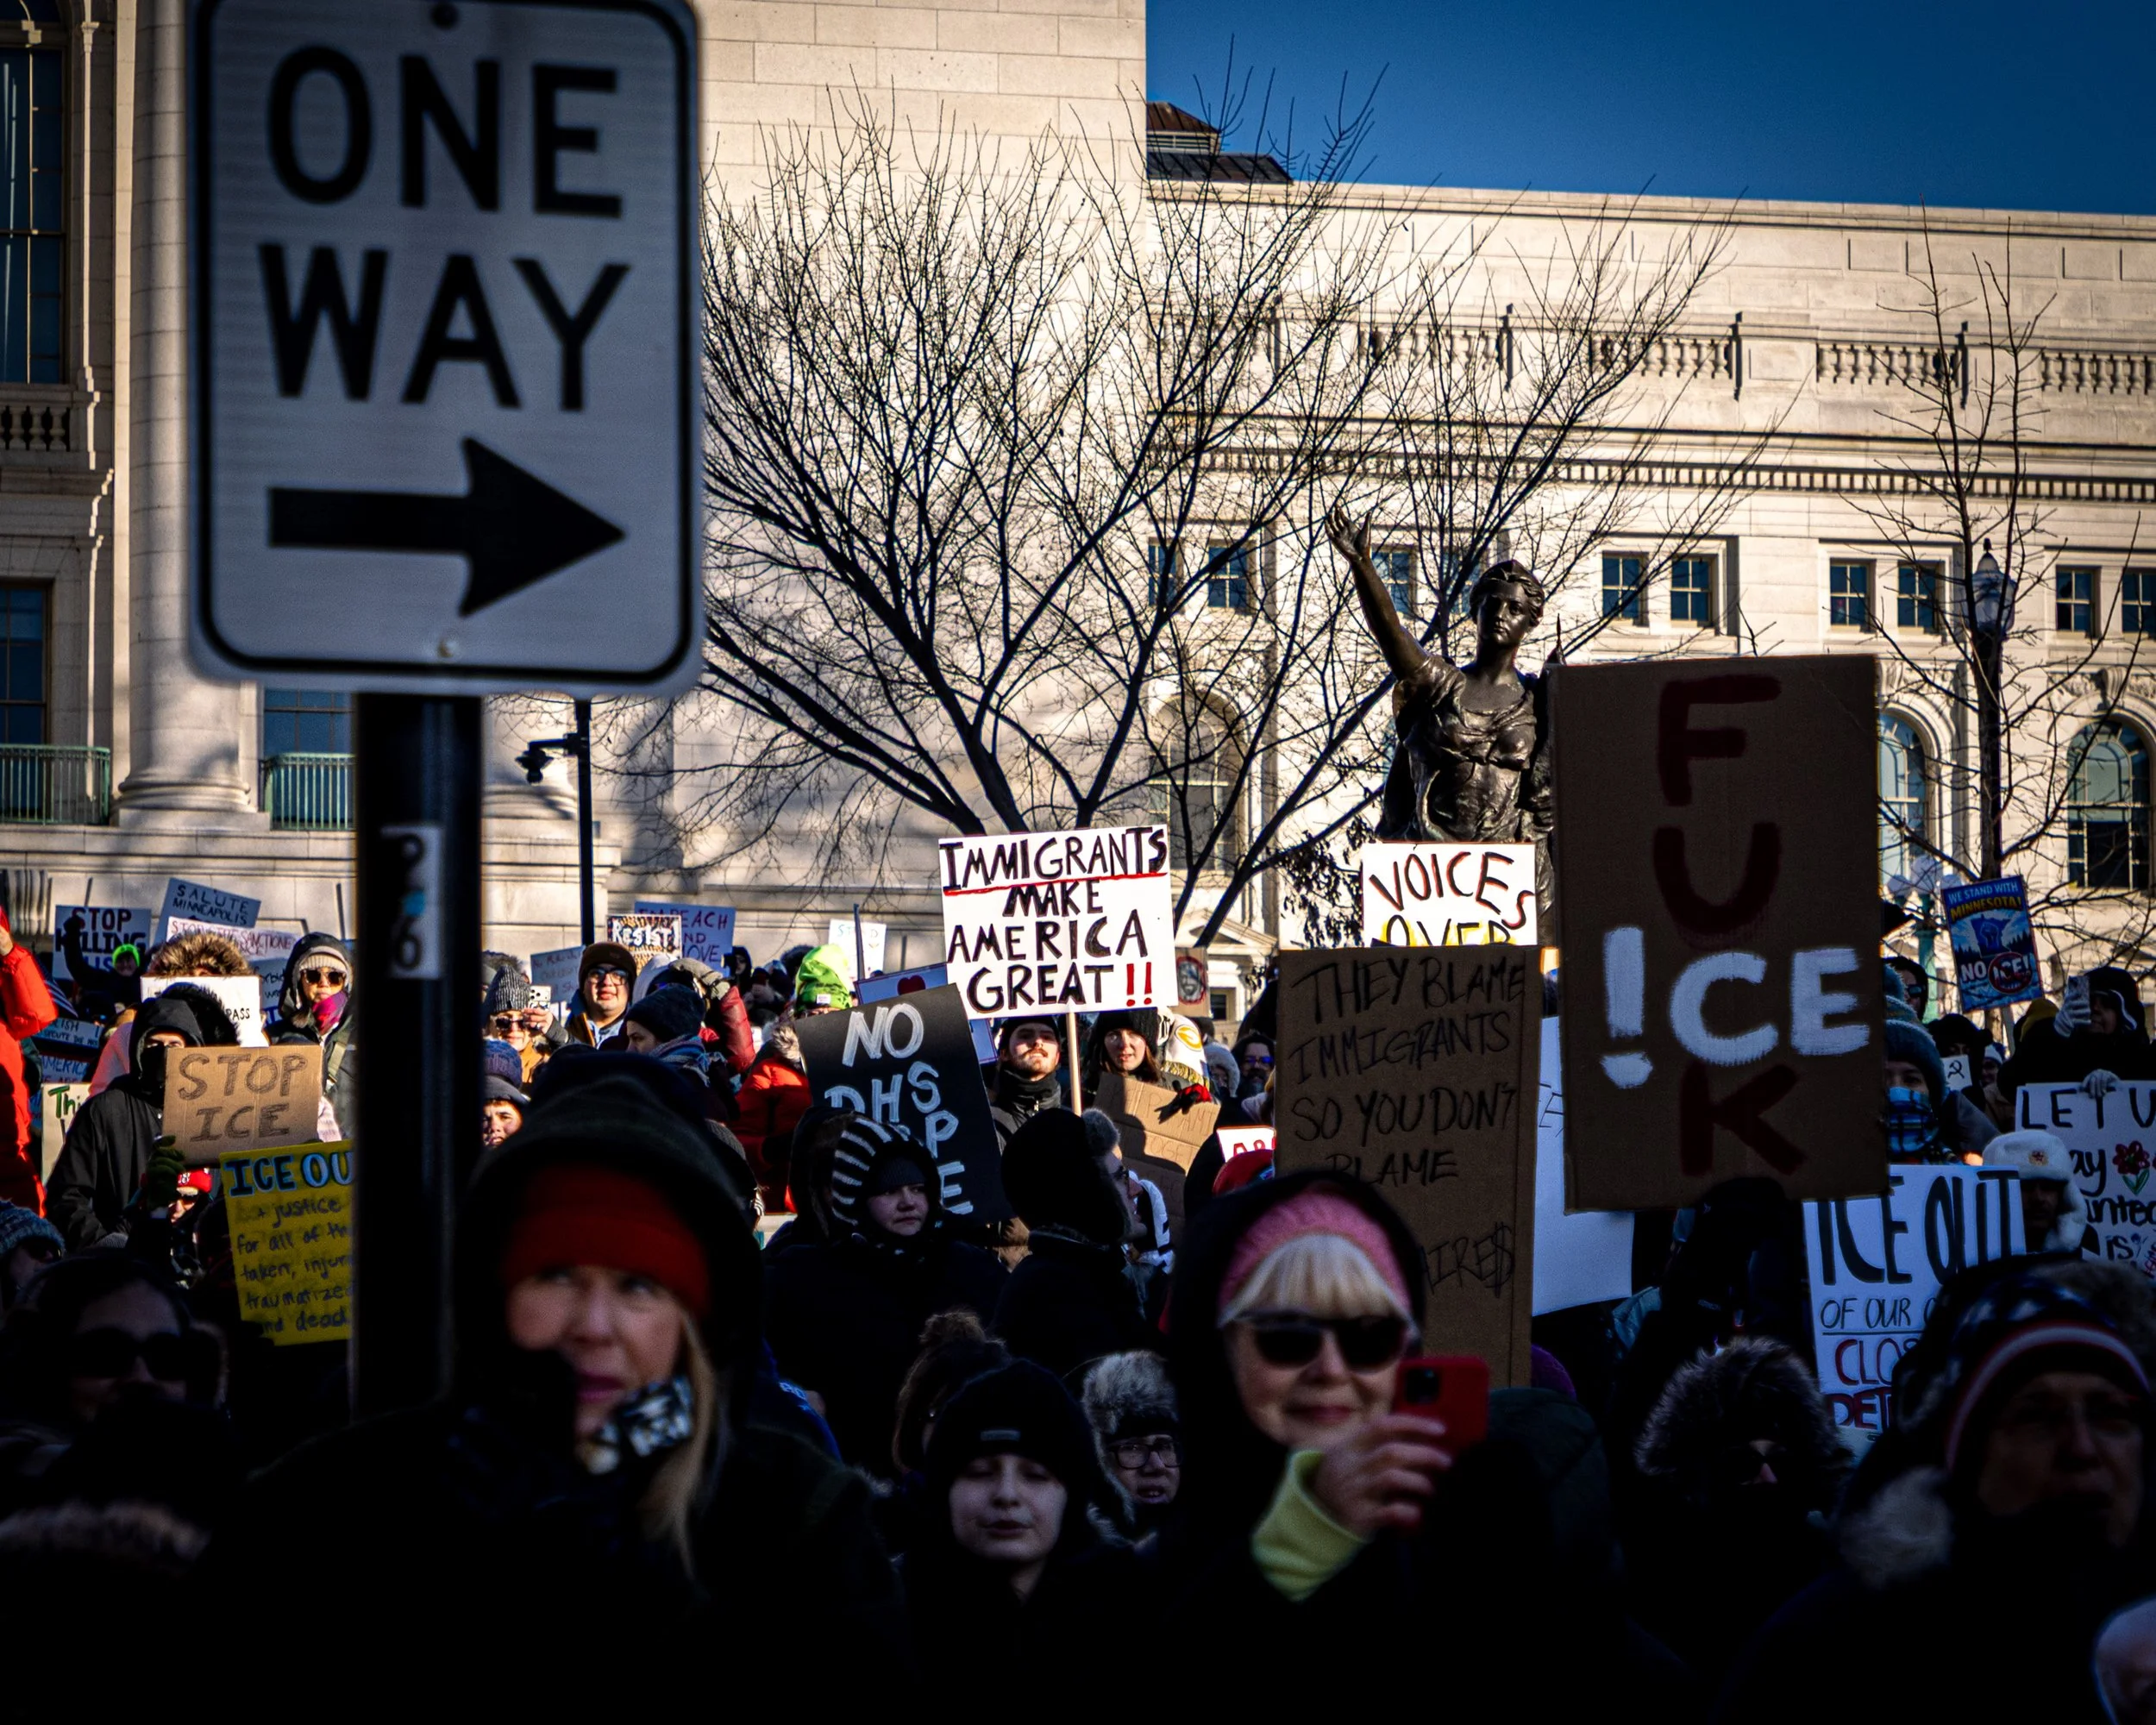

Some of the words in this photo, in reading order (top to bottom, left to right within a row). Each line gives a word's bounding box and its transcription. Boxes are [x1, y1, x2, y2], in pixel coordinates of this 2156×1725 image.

[267, 46, 624, 218] ONE
[258, 242, 632, 411] WAY
[941, 826, 1168, 890] IMMIGRANTS
[172, 898, 248, 925] MINNEAPOLIS
[177, 884, 249, 914] SALUTE
[1002, 878, 1104, 918] MAKE
[1369, 850, 1534, 930] VOICES
[1948, 891, 1964, 905] WE
[1964, 885, 1993, 899] STAND
[1993, 881, 2019, 894] WITH
[1950, 896, 2022, 922] MINNESOTA!
[948, 910, 1148, 964] AMERICA
[967, 963, 1114, 1014] GREAT
[1291, 957, 1408, 1025] THEY
[1420, 957, 1525, 1009] BLAME
[1960, 960, 1987, 982] NO
[842, 1003, 924, 1068] NO
[1288, 1011, 1510, 1085] IMMIGRANTS
[178, 1053, 308, 1101] STOP
[191, 1104, 291, 1143] ICE
[1291, 1096, 1343, 1142] SO
[1356, 1090, 1426, 1147] YOU
[2021, 1087, 2116, 1129] LET
[2128, 1087, 2156, 1128] U
[224, 1154, 297, 1197] ICE
[302, 1151, 354, 1189] OU
[272, 1195, 342, 1229] justice
[1815, 1175, 1913, 1286] ICE
[1924, 1170, 2020, 1285] OUT
[236, 1233, 260, 1254] for
[269, 1231, 295, 1251] all
[327, 1221, 350, 1240] th
[304, 1254, 352, 1279] injur
[245, 1284, 350, 1309] traumatize
[1821, 1297, 1858, 1329] OF
[1865, 1296, 1912, 1329] OUR
